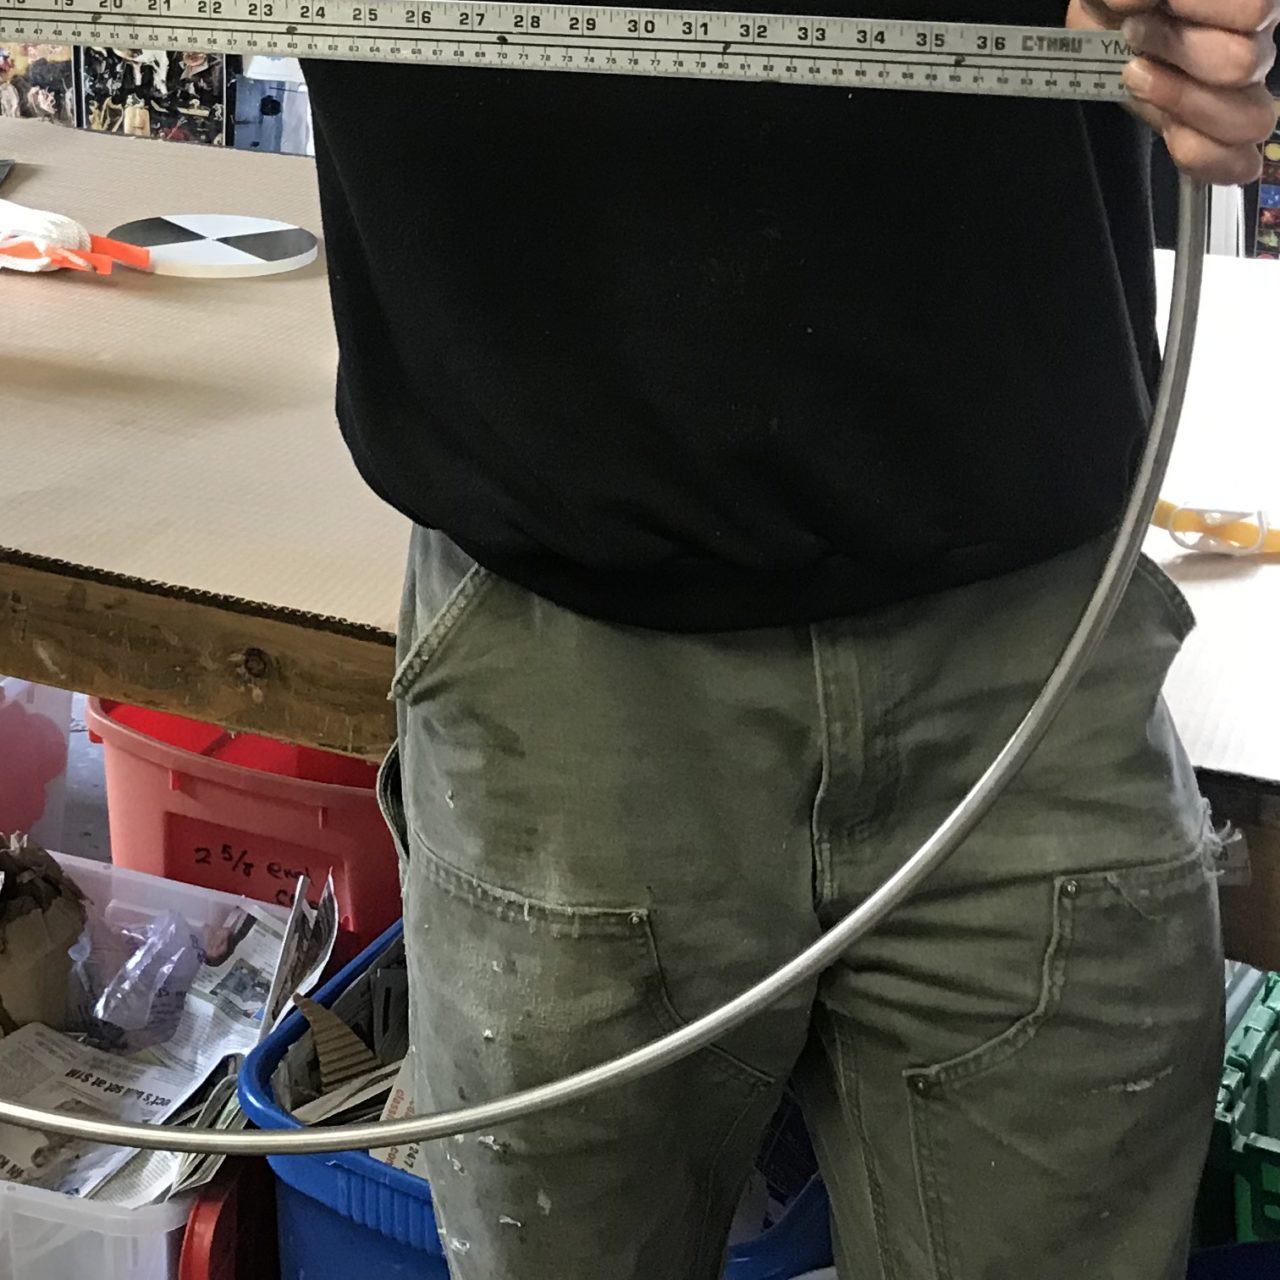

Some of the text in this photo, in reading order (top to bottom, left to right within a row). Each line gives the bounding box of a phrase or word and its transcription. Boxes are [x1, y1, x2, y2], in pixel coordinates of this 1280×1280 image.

[148, 0, 171, 11] 21
[198, 1, 222, 13] 22
[249, 3, 273, 16] 23
[301, 6, 325, 18] 24
[353, 8, 378, 21] 25
[405, 10, 431, 23] 26
[459, 13, 485, 26] 27
[514, 15, 540, 28] 28
[569, 17, 596, 30] 29
[628, 20, 655, 33] 30
[682, 22, 709, 35] 31
[740, 24, 767, 38] 32
[798, 27, 826, 41] 33
[857, 30, 885, 44] 34
[916, 33, 945, 48] 35
[977, 35, 1006, 50] 36
[194, 847, 212, 864] 2
[93, 1076, 108, 1089] at
[104, 1082, 122, 1095] set
